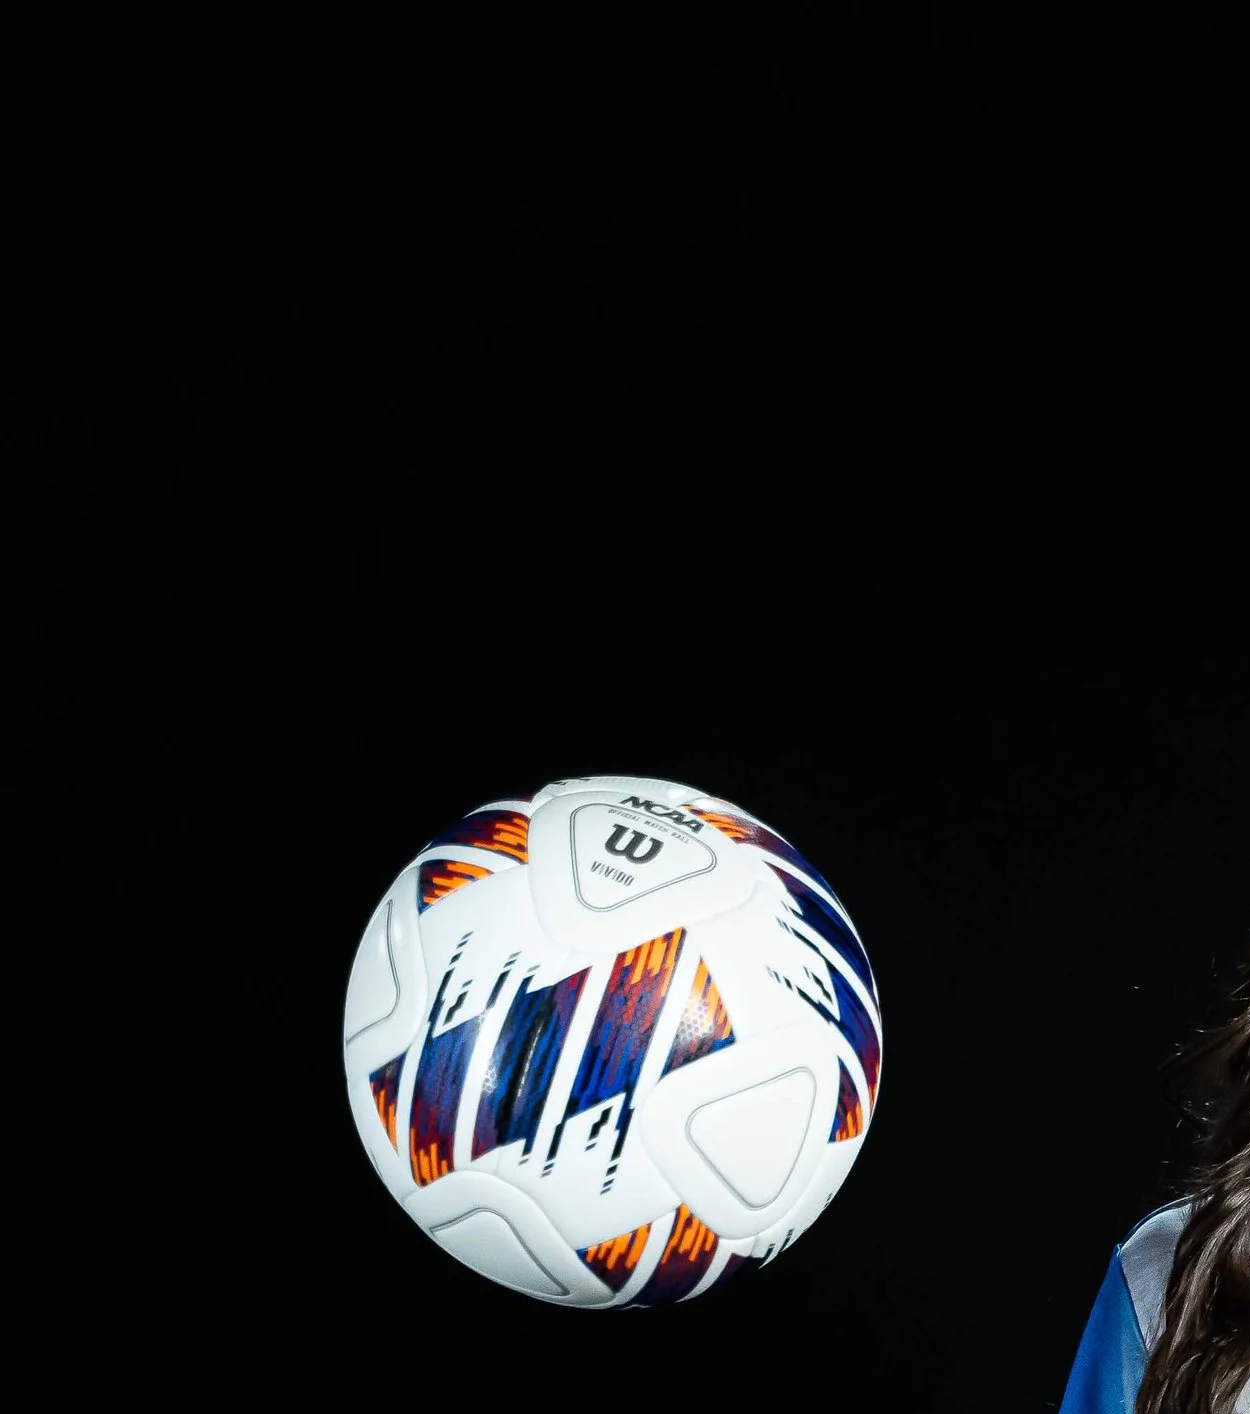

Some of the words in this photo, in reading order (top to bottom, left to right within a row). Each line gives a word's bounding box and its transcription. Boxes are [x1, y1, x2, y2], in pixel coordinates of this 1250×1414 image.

[607, 807, 640, 822] OFFICIAL
[643, 819, 669, 834] MATCH
[619, 795, 704, 834] NCAA
